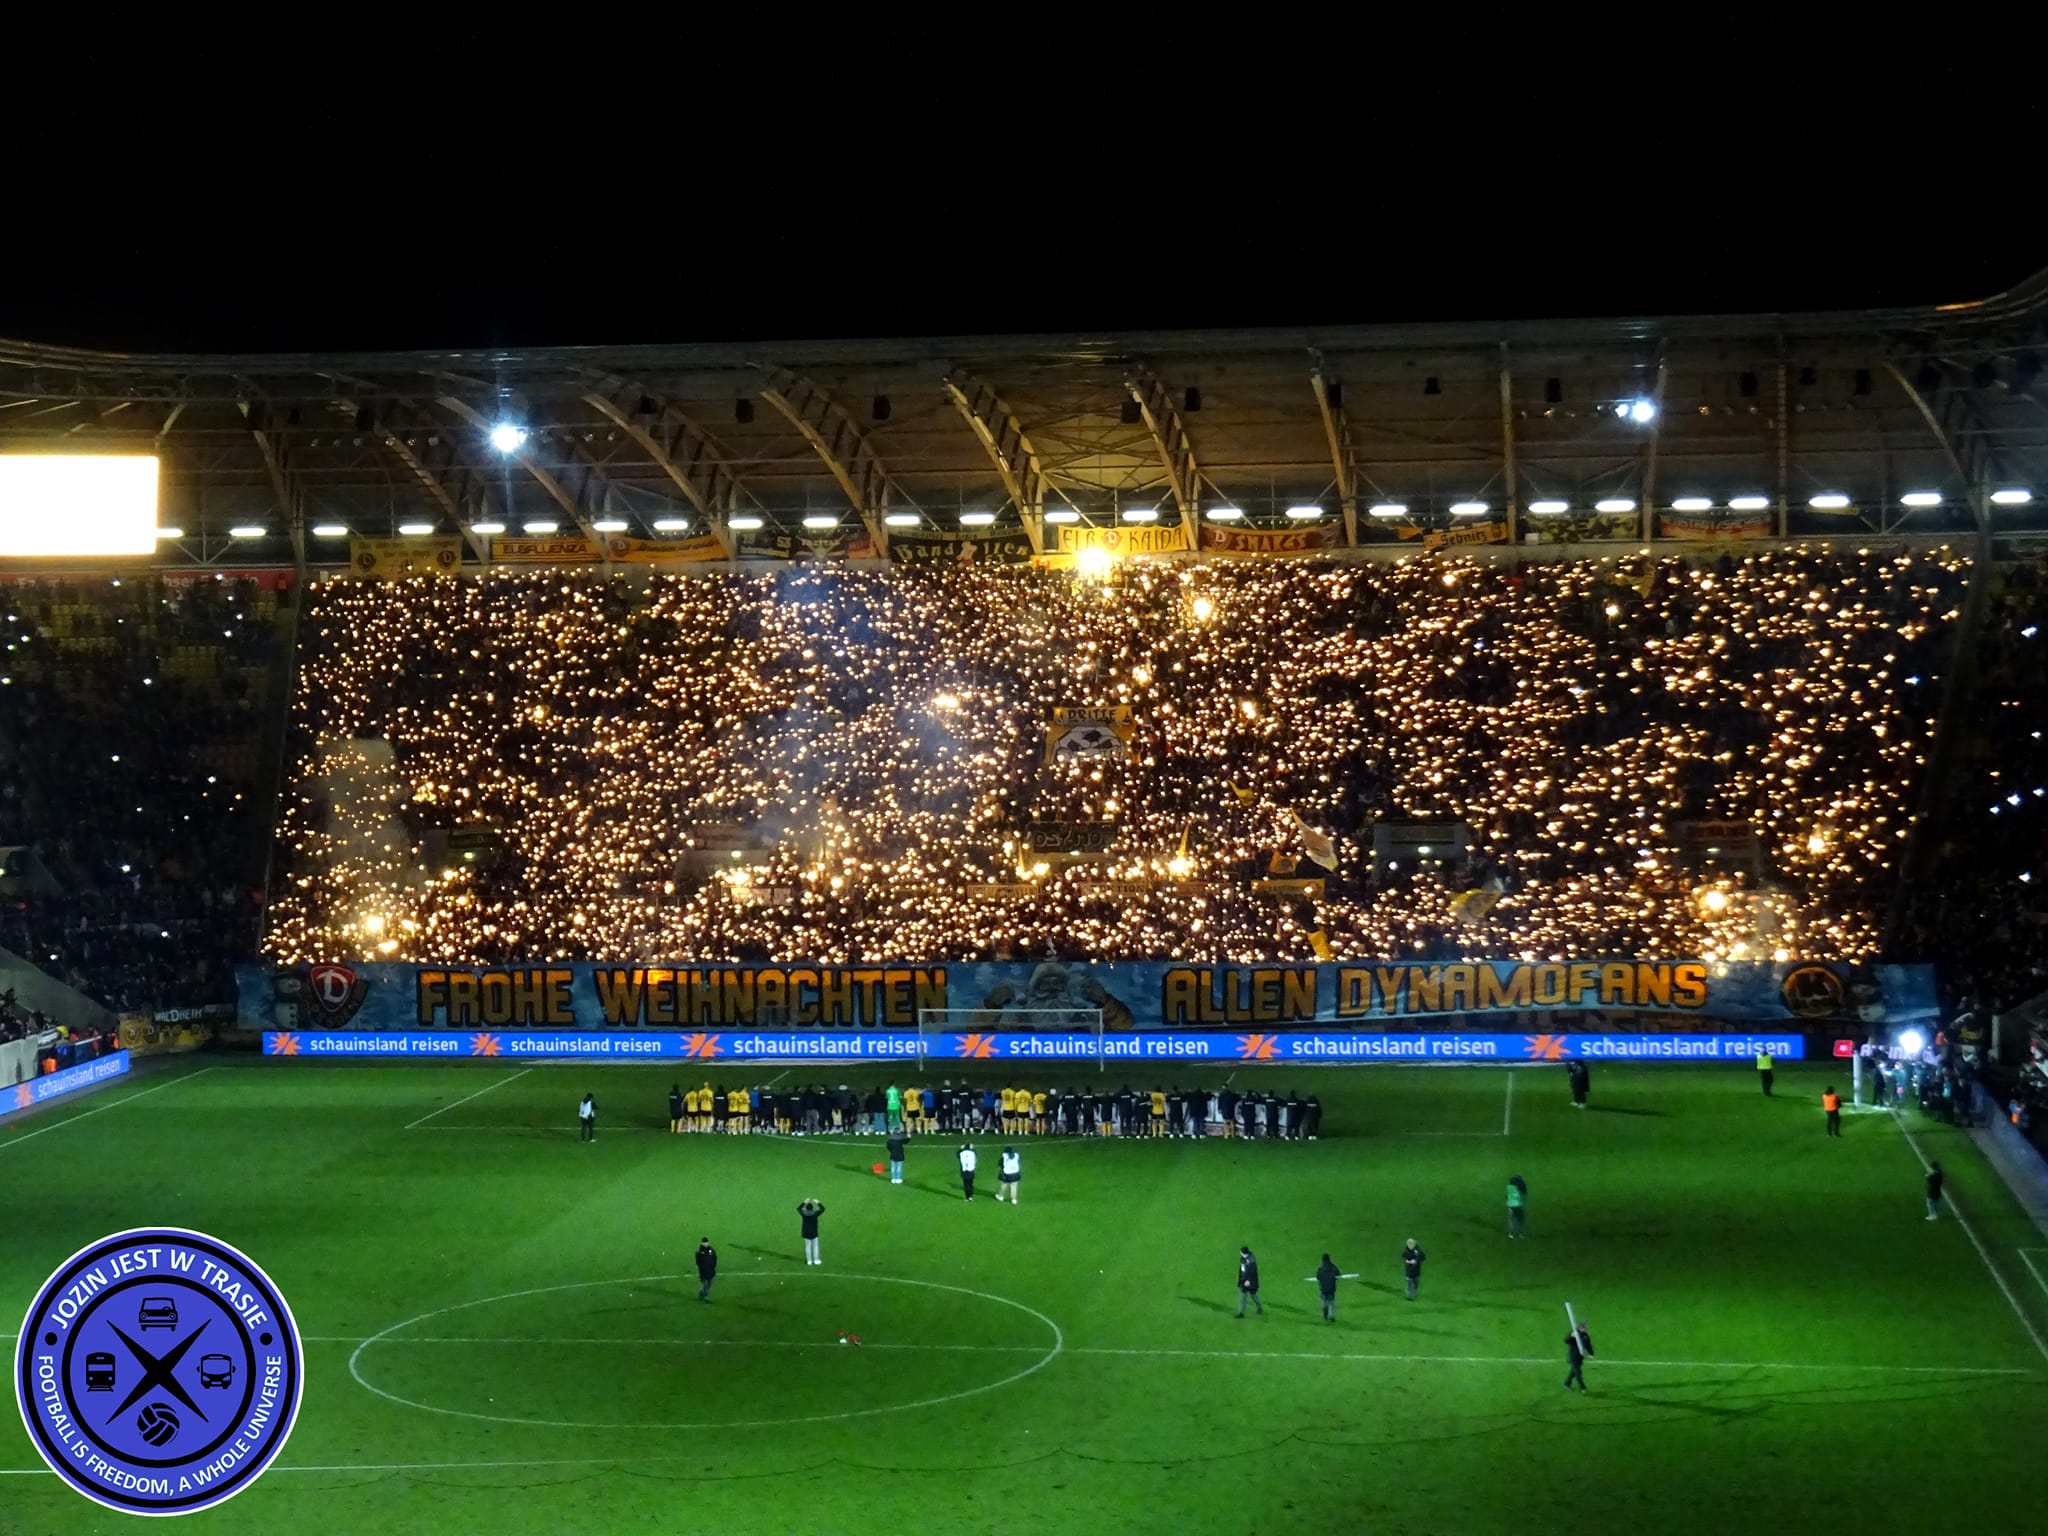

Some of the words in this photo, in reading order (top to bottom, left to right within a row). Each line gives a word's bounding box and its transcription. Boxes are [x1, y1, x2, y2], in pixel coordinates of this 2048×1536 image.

[1129, 526, 1183, 552] KAIDA
[417, 968, 575, 1027] FROHE
[595, 968, 948, 1027] WEIHNACHTEN
[1162, 967, 1317, 1026] ALLEN
[1335, 962, 1708, 1018] DYNAMOFANS
[309, 1036, 408, 1052] schauinsland
[412, 1037, 459, 1052] reisen
[511, 1037, 610, 1052] schauinsland
[614, 1037, 661, 1052] reisen
[732, 1036, 862, 1054] schauinsland
[867, 1036, 928, 1054] reisen
[1009, 1036, 1140, 1055] schauinsland
[1146, 1036, 1209, 1055] reisen
[1291, 1036, 1426, 1055] schauinsland
[1432, 1036, 1496, 1055] reisen
[1580, 1037, 1718, 1056] schauinsland
[1723, 1037, 1791, 1056] reisen
[37, 1063, 95, 1099] schauinsland
[95, 1058, 121, 1078] reisen
